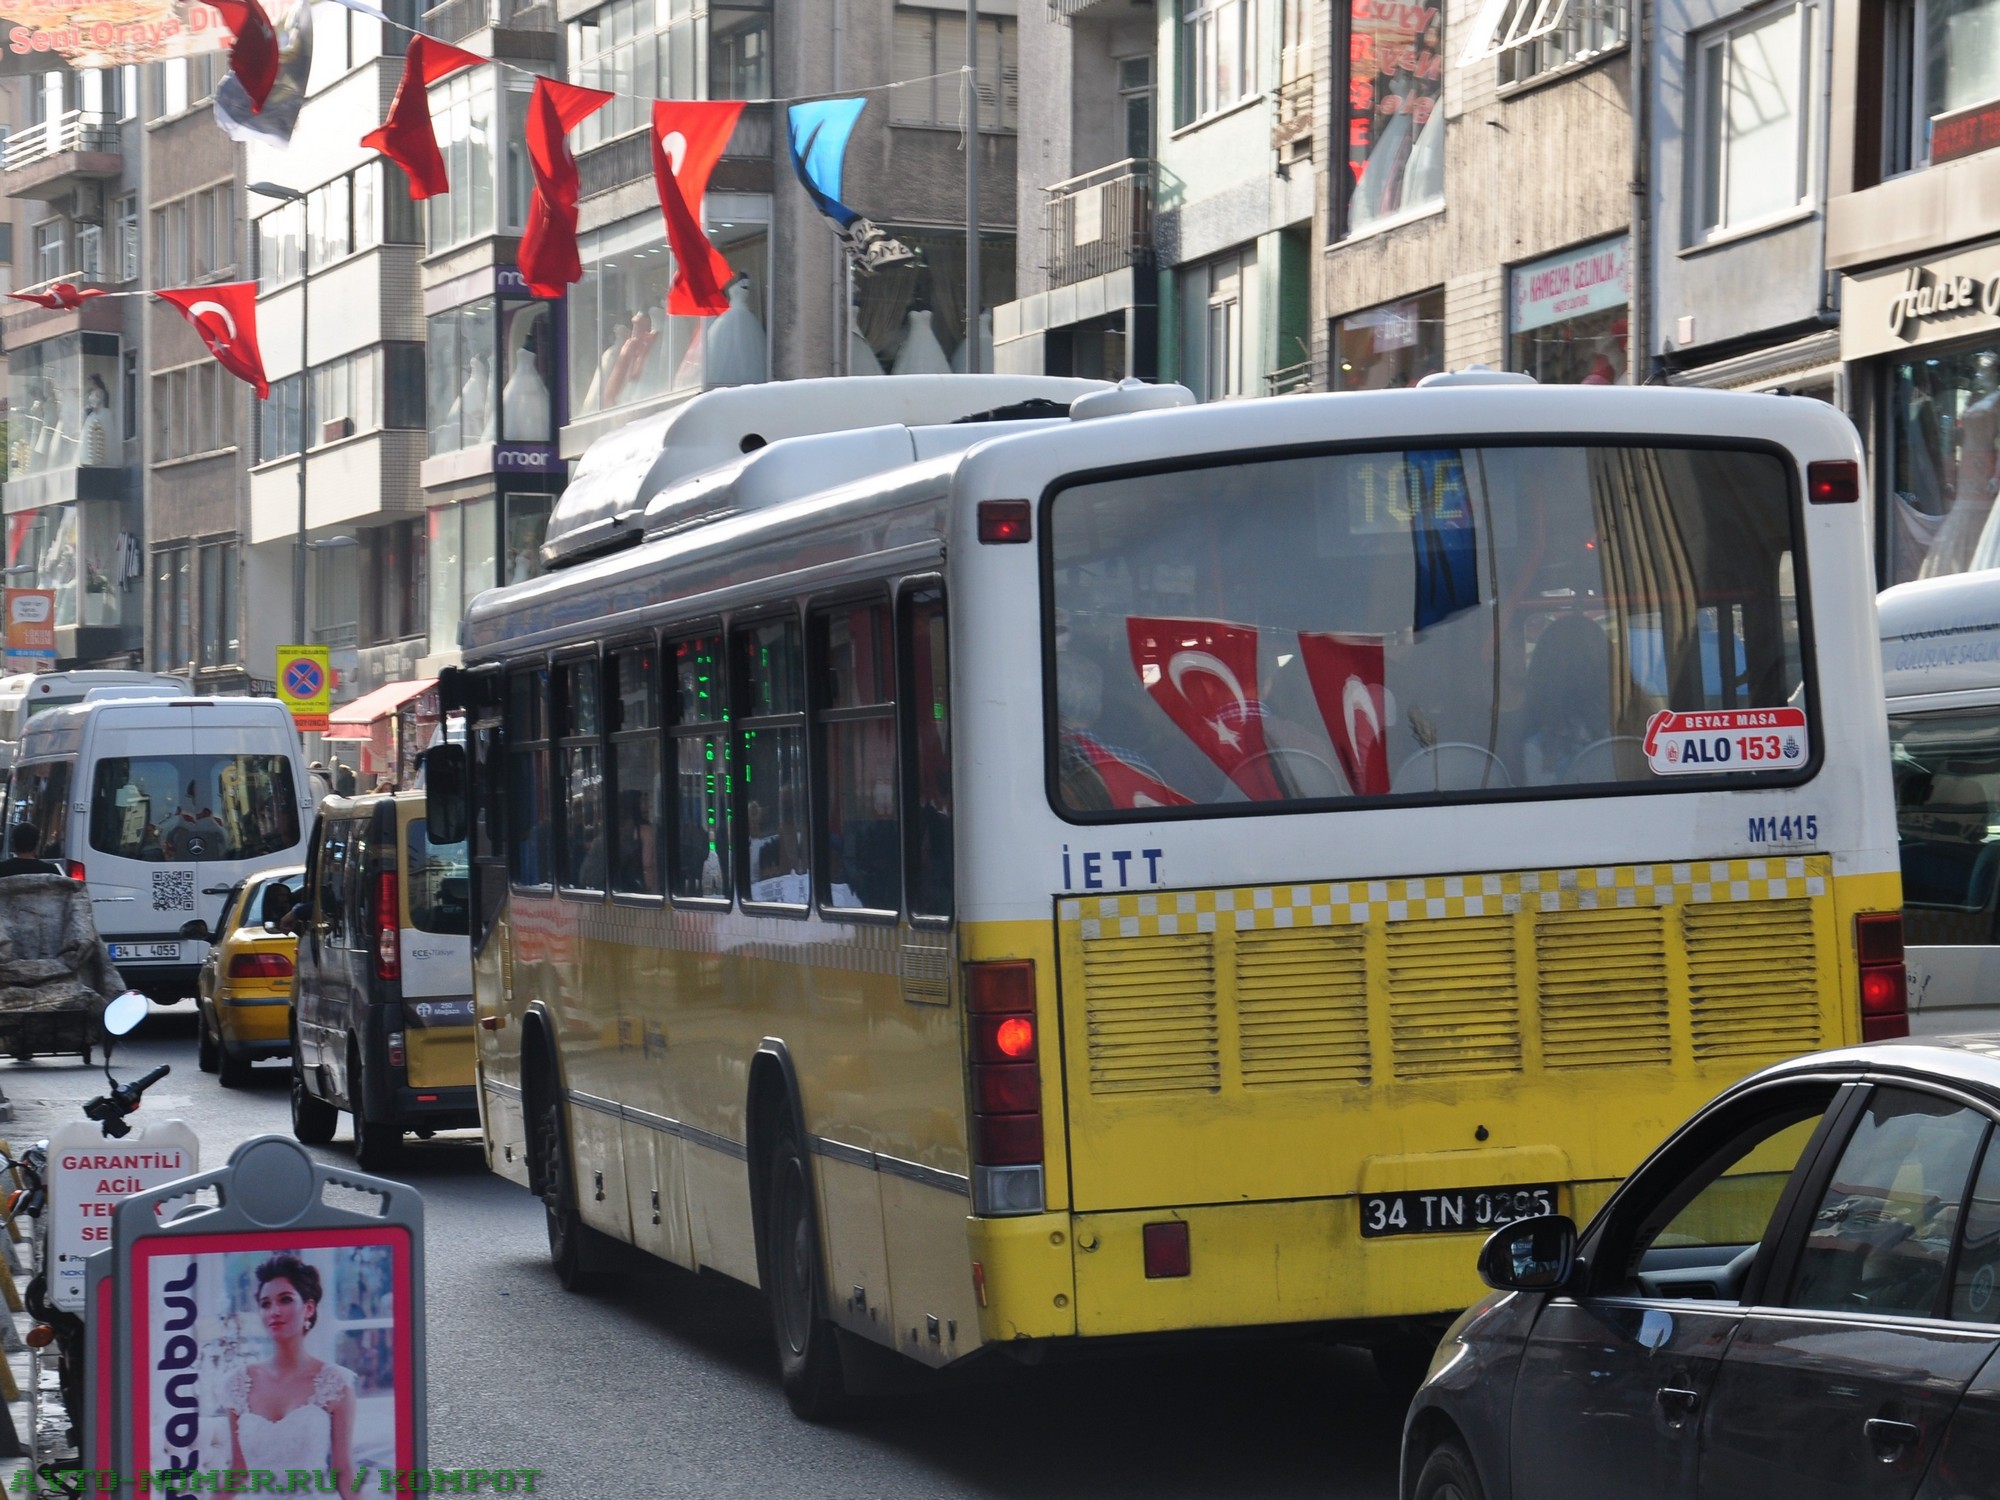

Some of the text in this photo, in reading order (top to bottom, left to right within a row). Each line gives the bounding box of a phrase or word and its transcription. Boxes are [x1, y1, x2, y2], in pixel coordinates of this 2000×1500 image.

[9, 23, 81, 54] Seni
[90, 15, 182, 47] Oraya
[1530, 265, 1570, 303] KAMELYA
[1888, 266, 1974, 337] Hanse
[1358, 459, 1462, 522] 10E
[1685, 713, 1777, 728] BEYAZ MASA
[1682, 735, 1781, 763] ALO 153
[1749, 815, 1818, 843] M1415
[1062, 844, 1162, 889] İETT
[115, 945, 176, 957] 34 L 4055
[62, 1152, 181, 1170] GARANTİLİ
[96, 1176, 147, 1194] ACİL
[1368, 1198, 1408, 1230] 34
[1420, 1196, 1464, 1227] TN
